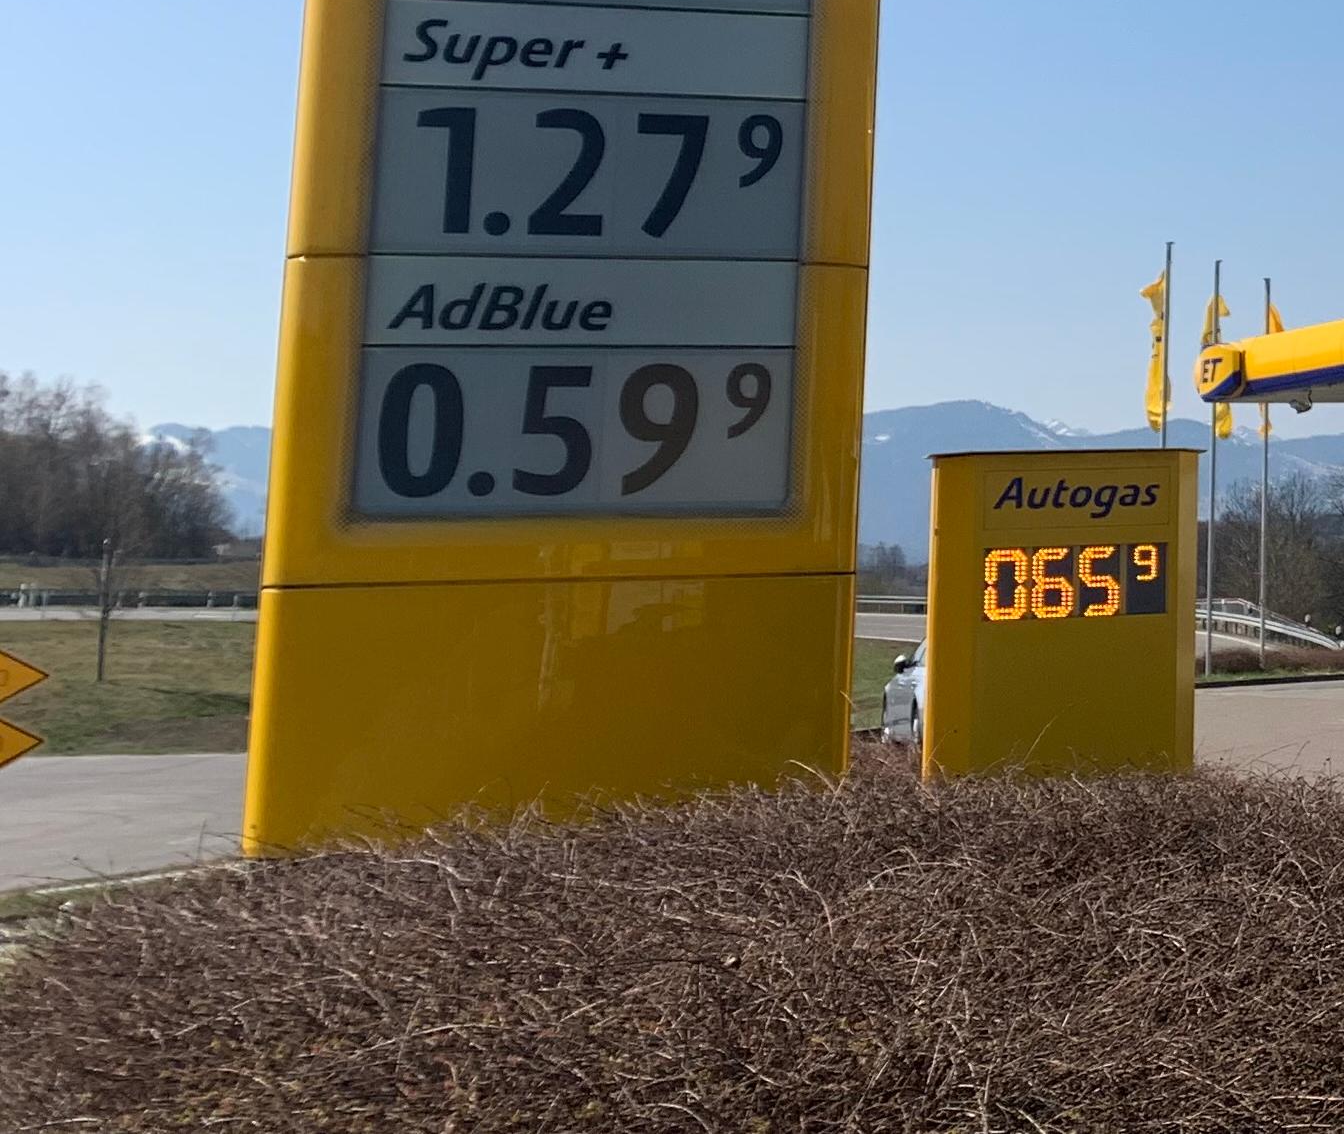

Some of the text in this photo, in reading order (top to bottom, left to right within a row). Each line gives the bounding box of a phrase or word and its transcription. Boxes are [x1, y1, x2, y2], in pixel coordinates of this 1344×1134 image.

[386, 282, 612, 331] AdBlue
[1202, 357, 1223, 383] ET
[993, 477, 1160, 519] Autogas
